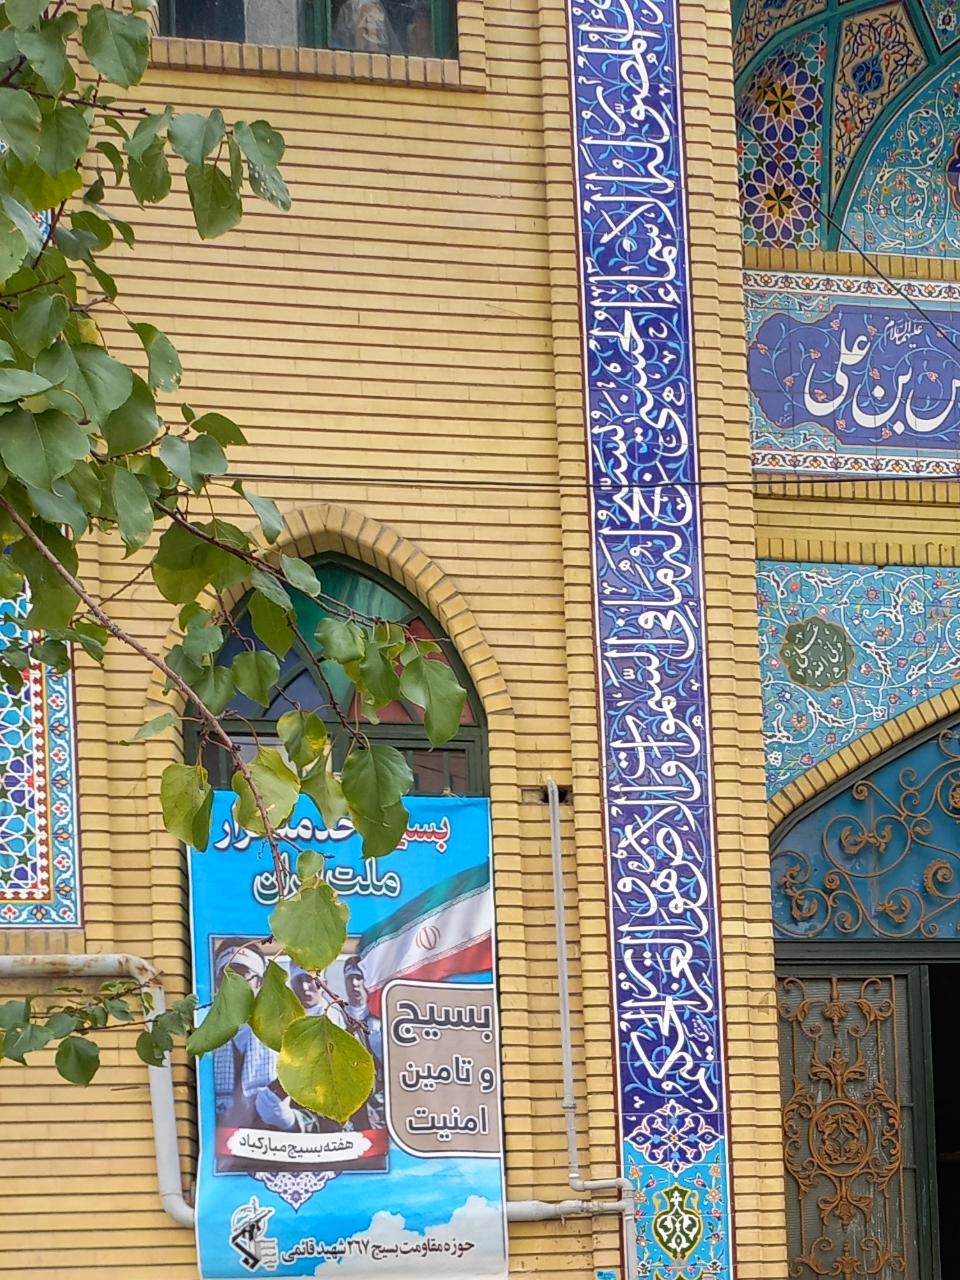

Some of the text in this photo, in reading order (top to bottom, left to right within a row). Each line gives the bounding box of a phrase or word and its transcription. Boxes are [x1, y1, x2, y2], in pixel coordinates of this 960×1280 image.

[804, 328, 871, 416] علی
[852, 368, 914, 436] بن
[326, 857, 401, 897] ملت
[391, 1000, 493, 1045] بسیج
[400, 1055, 496, 1093] و تامین
[406, 1104, 489, 1141] امنیت
[287, 1143, 324, 1159] بسیج
[324, 1137, 354, 1153] هفته
[318, 1238, 346, 1262] شهید
[371, 1242, 399, 1261] بسیج
[400, 1238, 444, 1258] مقاومت
[445, 1240, 476, 1259] حوزه
